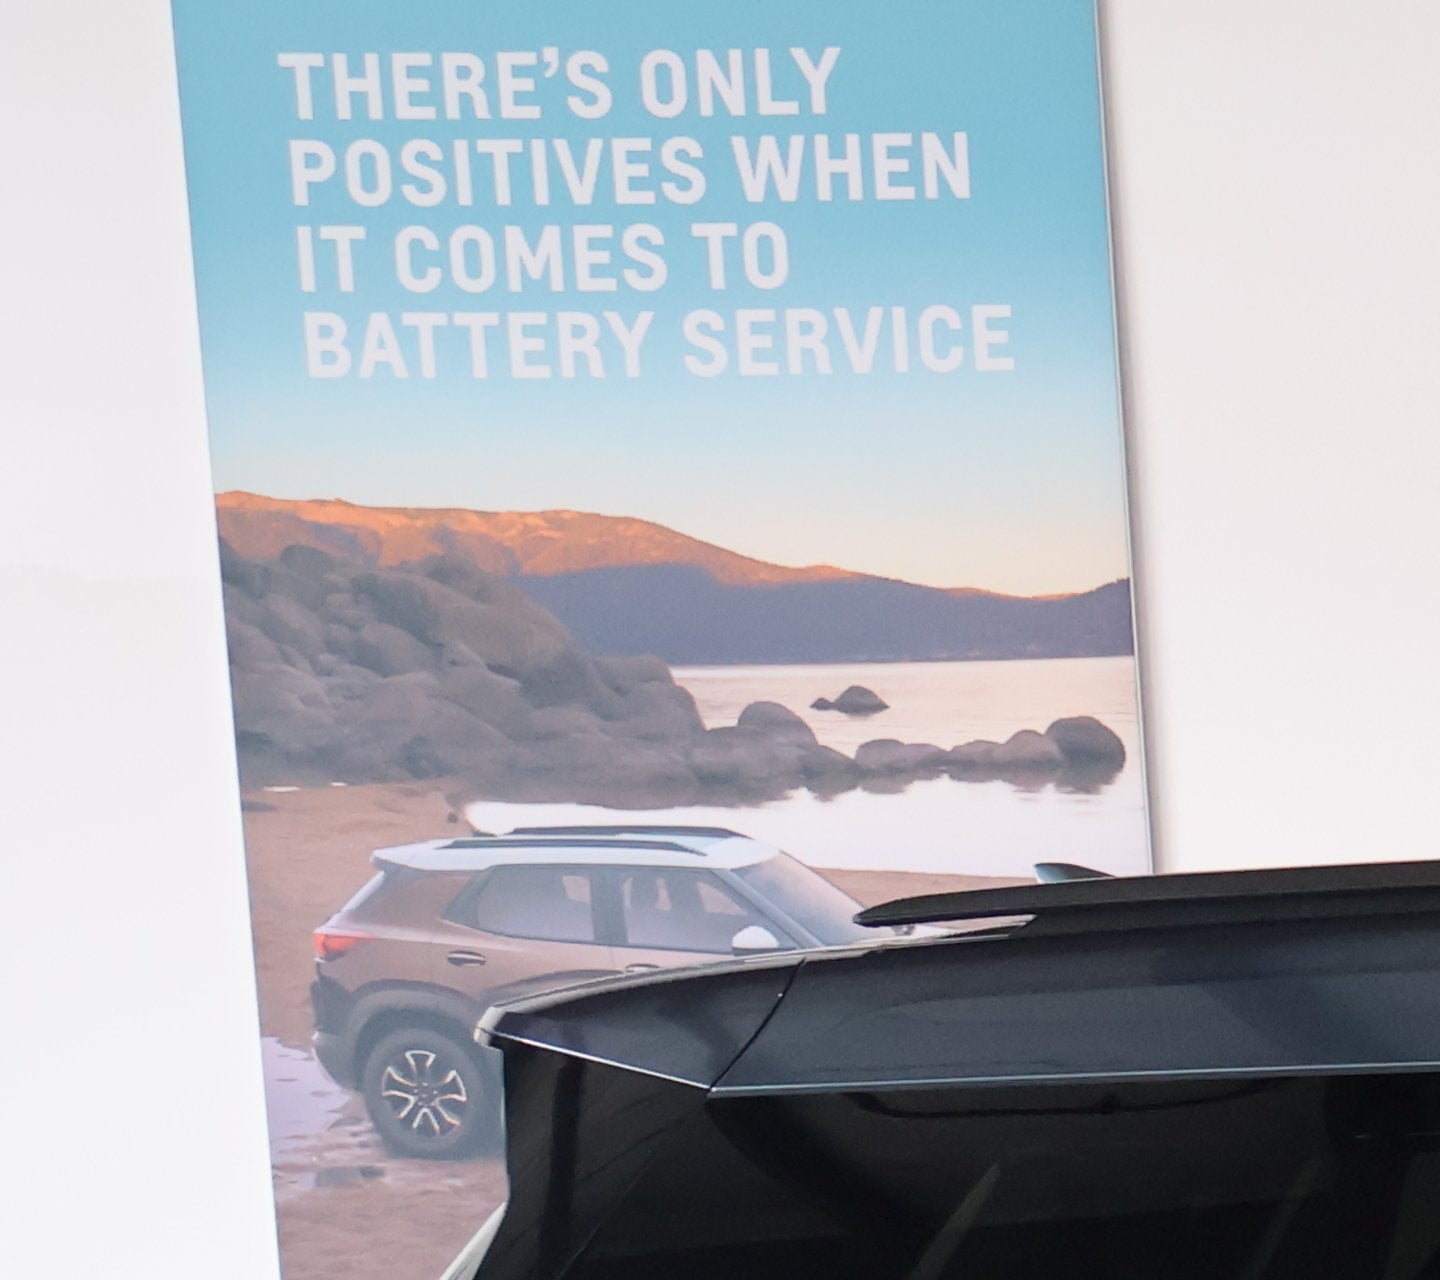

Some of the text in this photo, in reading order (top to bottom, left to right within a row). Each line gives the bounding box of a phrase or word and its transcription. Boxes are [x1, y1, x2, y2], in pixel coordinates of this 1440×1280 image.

[277, 46, 841, 120] THERE'S ONLY
[289, 131, 970, 207] POSITIVES WHEN
[296, 221, 789, 294] IT COMES TO
[303, 306, 1015, 380] BATTERY SERVICE
